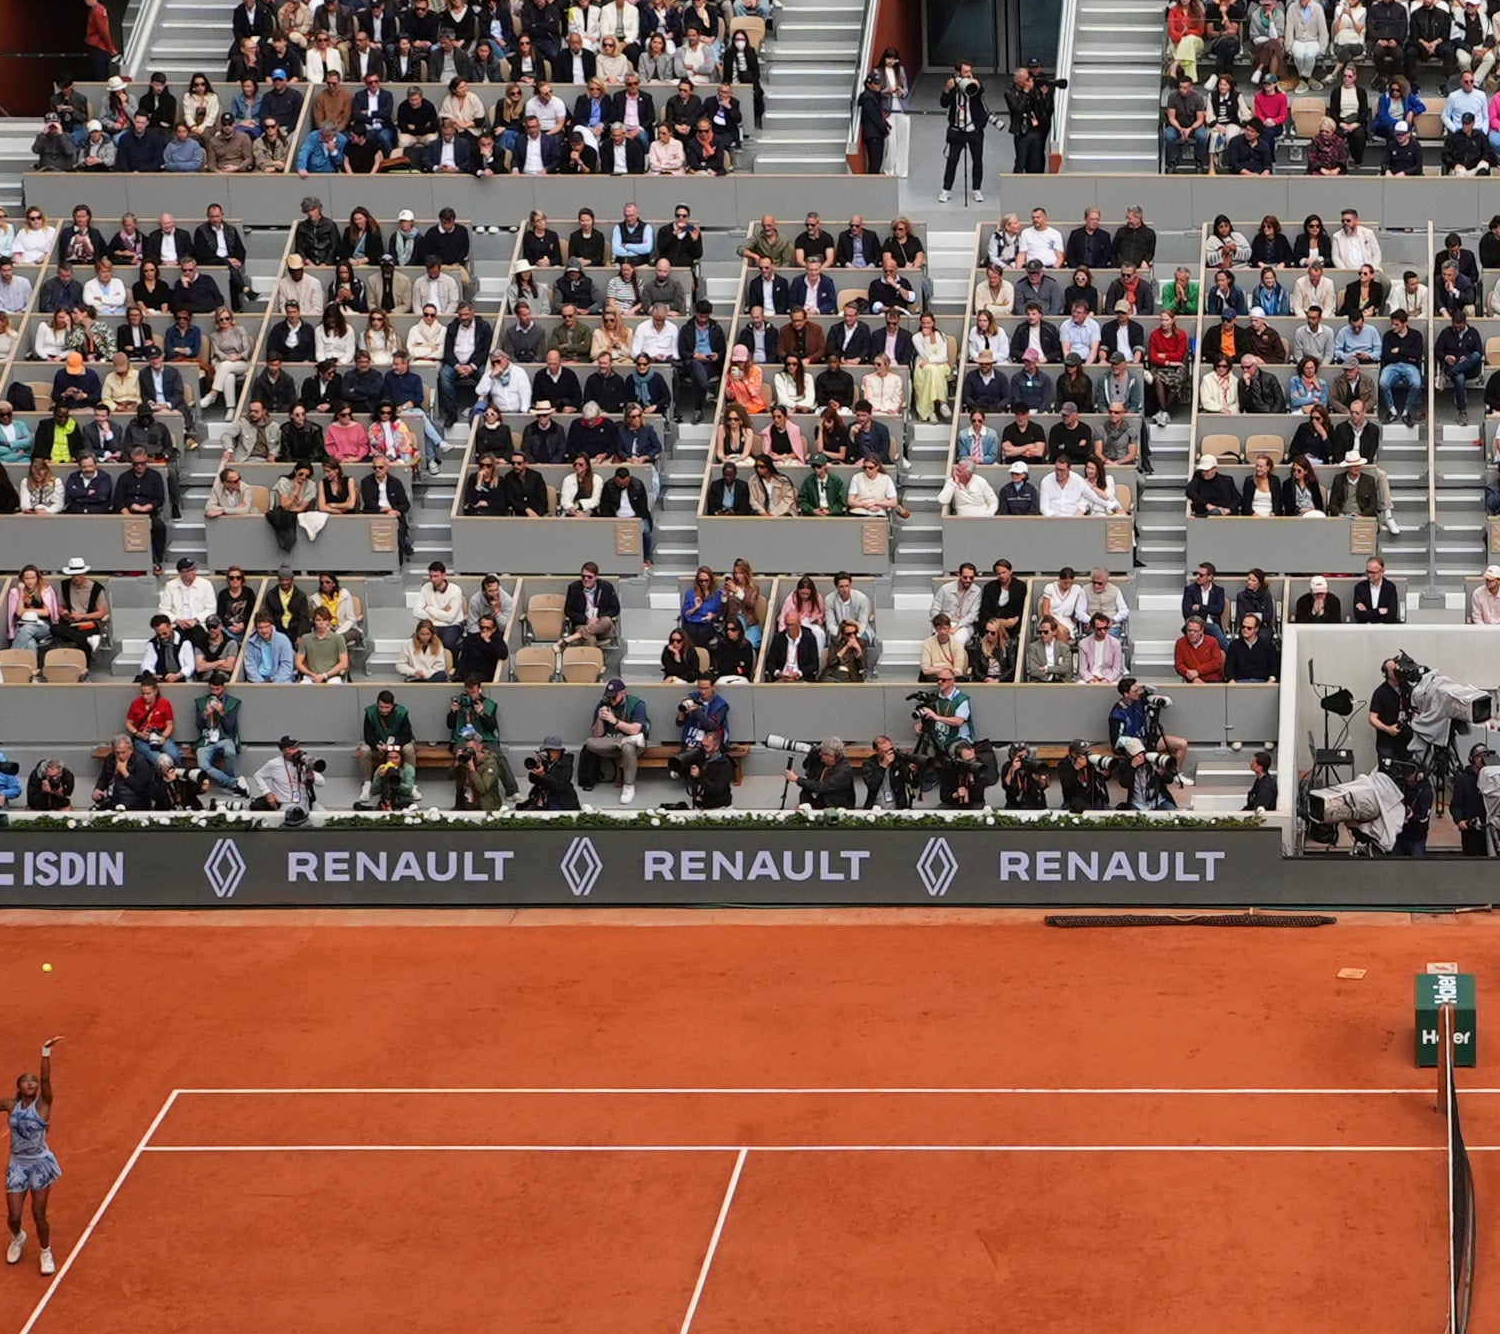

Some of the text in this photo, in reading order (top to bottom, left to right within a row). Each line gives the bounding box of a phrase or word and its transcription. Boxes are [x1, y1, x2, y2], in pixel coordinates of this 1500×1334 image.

[23, 851, 125, 886] ISDIN
[287, 851, 515, 883] RENAULT
[643, 851, 871, 883] RENAULT
[999, 851, 1227, 883] RENAULT
[1422, 1029, 1471, 1045] Her
